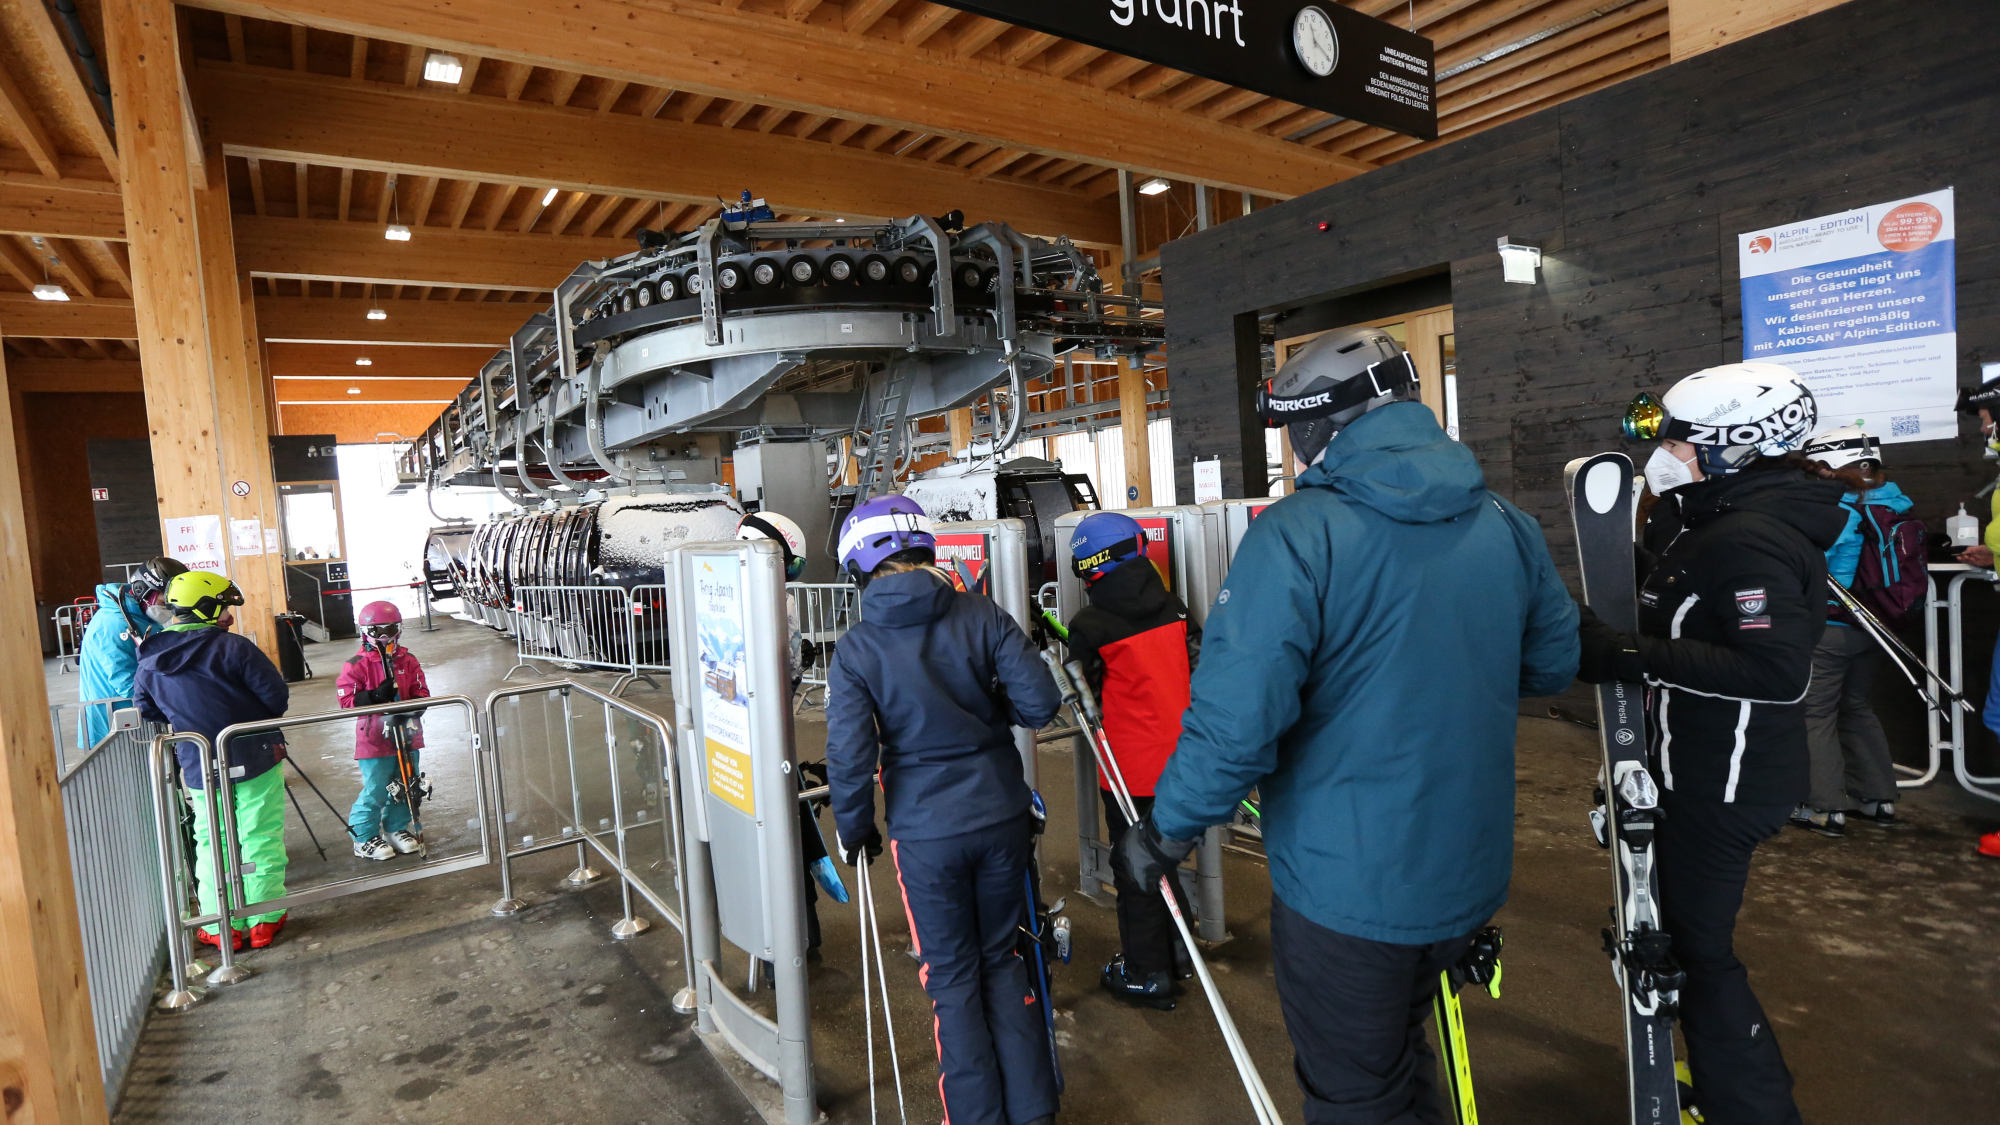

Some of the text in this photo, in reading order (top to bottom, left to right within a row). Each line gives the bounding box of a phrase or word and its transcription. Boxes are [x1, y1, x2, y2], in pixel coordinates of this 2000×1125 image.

[1380, 54, 1405, 68] EINSTEIGEN
[1365, 85, 1390, 98] UNBEDINGT
[1391, 93, 1404, 103] FOLGE
[1371, 77, 1422, 100] BEDIENUNGSPERSONALS
[1380, 71, 1428, 94] DEN ANWEISUNGEN DES
[1779, 227, 1808, 239] ALPIN
[1820, 215, 1863, 231] EDITION
[1791, 260, 1893, 285] Die Gesundheit
[1768, 269, 1921, 301] unserer Gäste liegt uns
[1765, 295, 1925, 325] Wir desinfizieren unsere
[1790, 287, 1896, 310] sehr am Herzen.
[1778, 310, 1910, 336] Kabinen regelmäßig
[1754, 342, 1773, 351] mit
[1618, 700, 1627, 724] Presta
